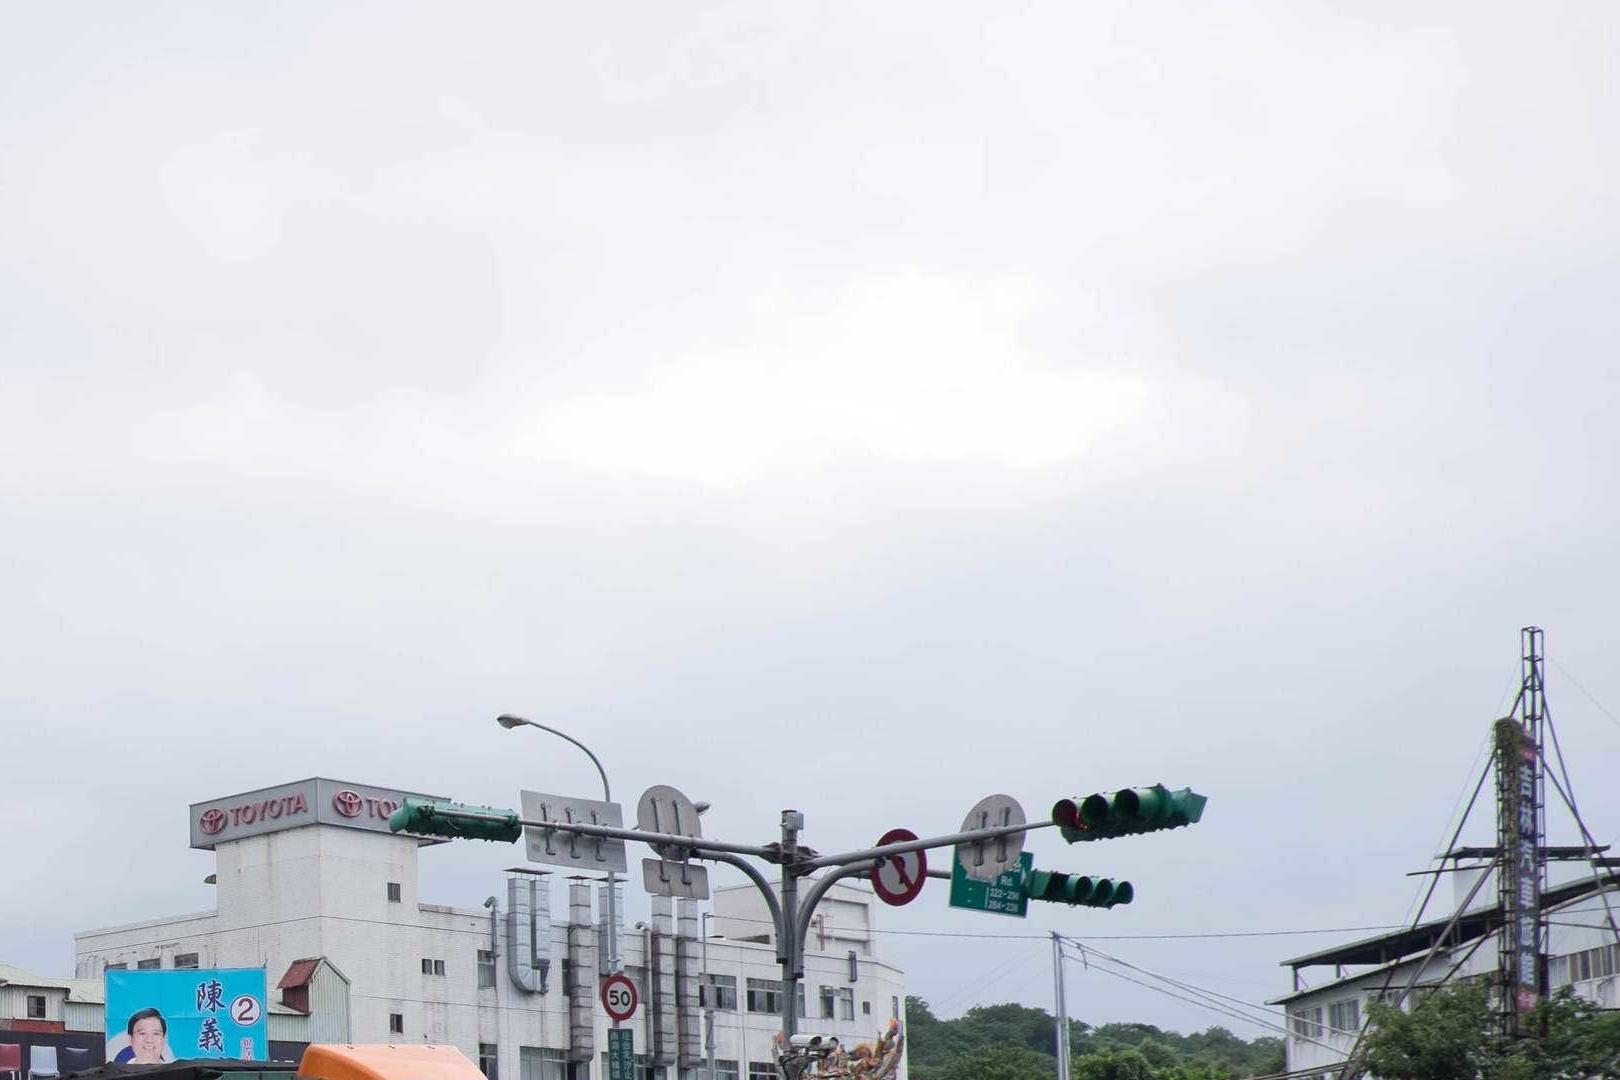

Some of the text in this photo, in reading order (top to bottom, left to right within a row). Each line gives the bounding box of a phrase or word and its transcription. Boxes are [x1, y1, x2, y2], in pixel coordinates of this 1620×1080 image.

[230, 793, 307, 826] TOYOTA
[238, 997, 254, 1021] 2
[609, 990, 630, 1006] 50
